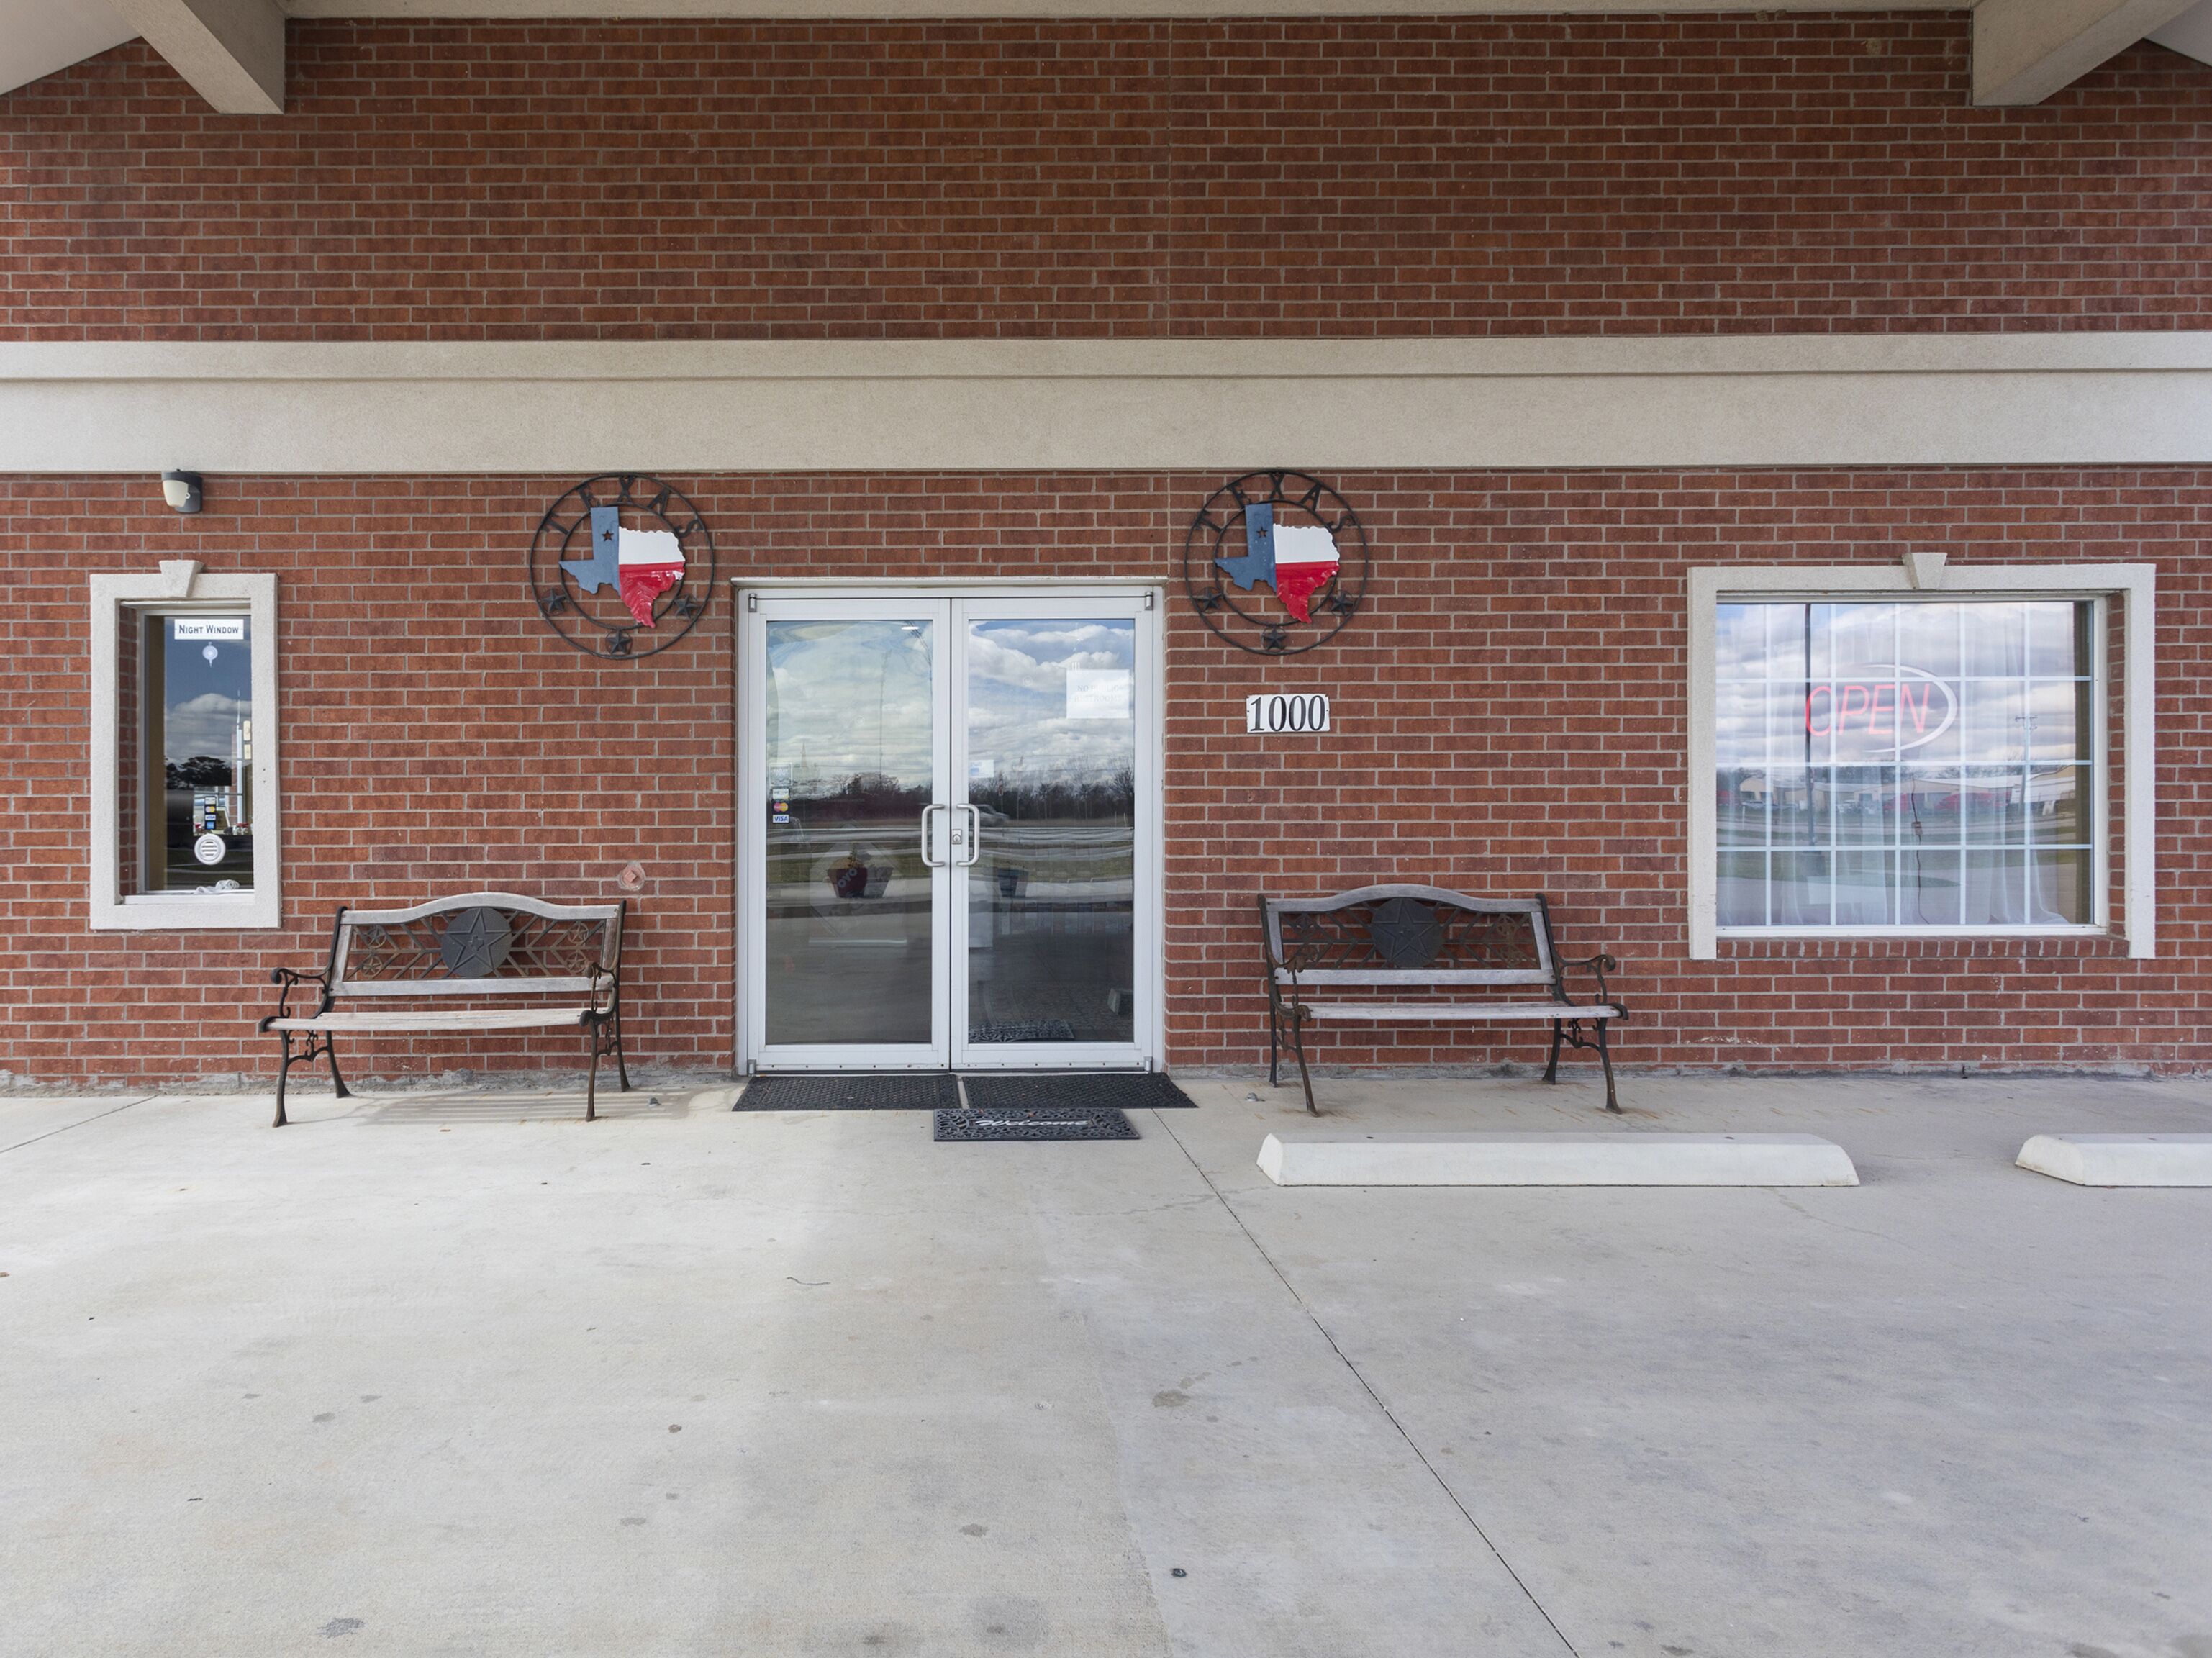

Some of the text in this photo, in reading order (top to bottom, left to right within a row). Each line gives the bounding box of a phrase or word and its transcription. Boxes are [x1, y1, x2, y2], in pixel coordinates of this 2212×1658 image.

[541, 474, 704, 537] TEXAS
[1195, 472, 1358, 533] TEXAS
[1250, 694, 1326, 732] 1000
[1805, 683, 1931, 737] OPEN
